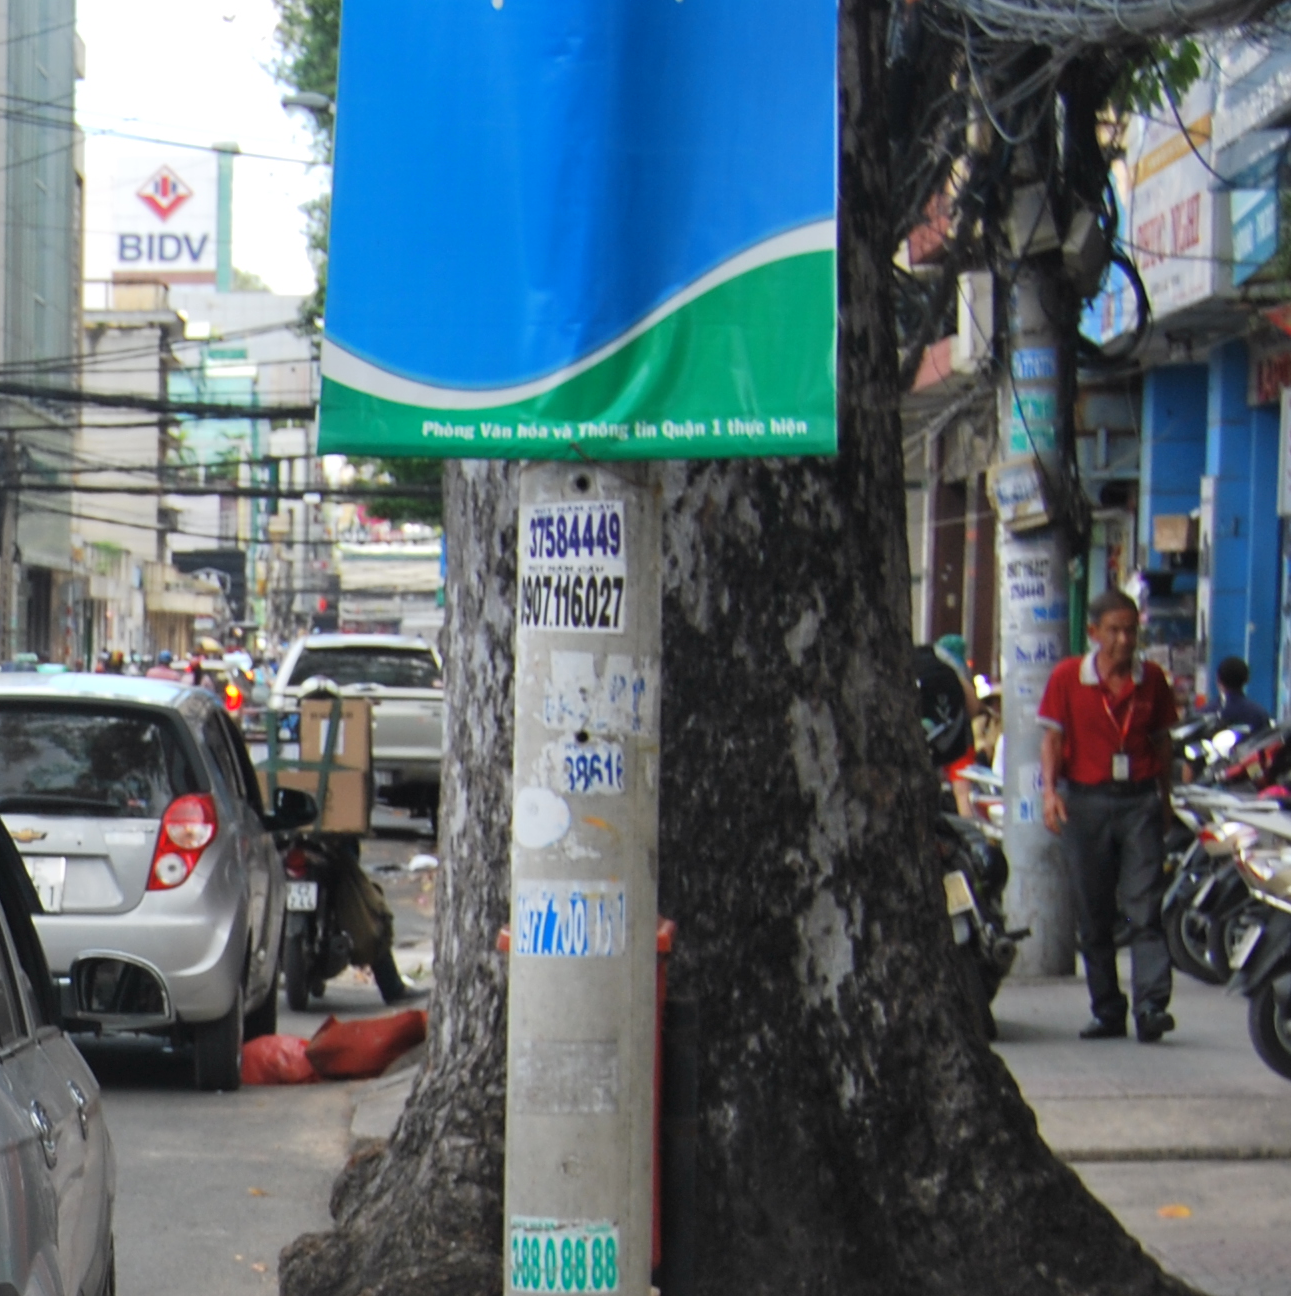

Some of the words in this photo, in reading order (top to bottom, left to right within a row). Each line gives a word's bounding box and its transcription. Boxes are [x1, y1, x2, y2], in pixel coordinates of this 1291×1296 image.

[118, 233, 208, 262] BIDV
[422, 420, 476, 440] Phòng
[480, 421, 512, 439] Văn
[517, 421, 549, 439] hóa
[553, 423, 573, 439] và
[578, 420, 629, 441] Thông
[634, 420, 658, 439] tin
[661, 420, 706, 440] Quận
[712, 419, 721, 436] 1
[727, 417, 765, 439] thực
[770, 418, 808, 438] hiện
[529, 511, 621, 558] 37584449
